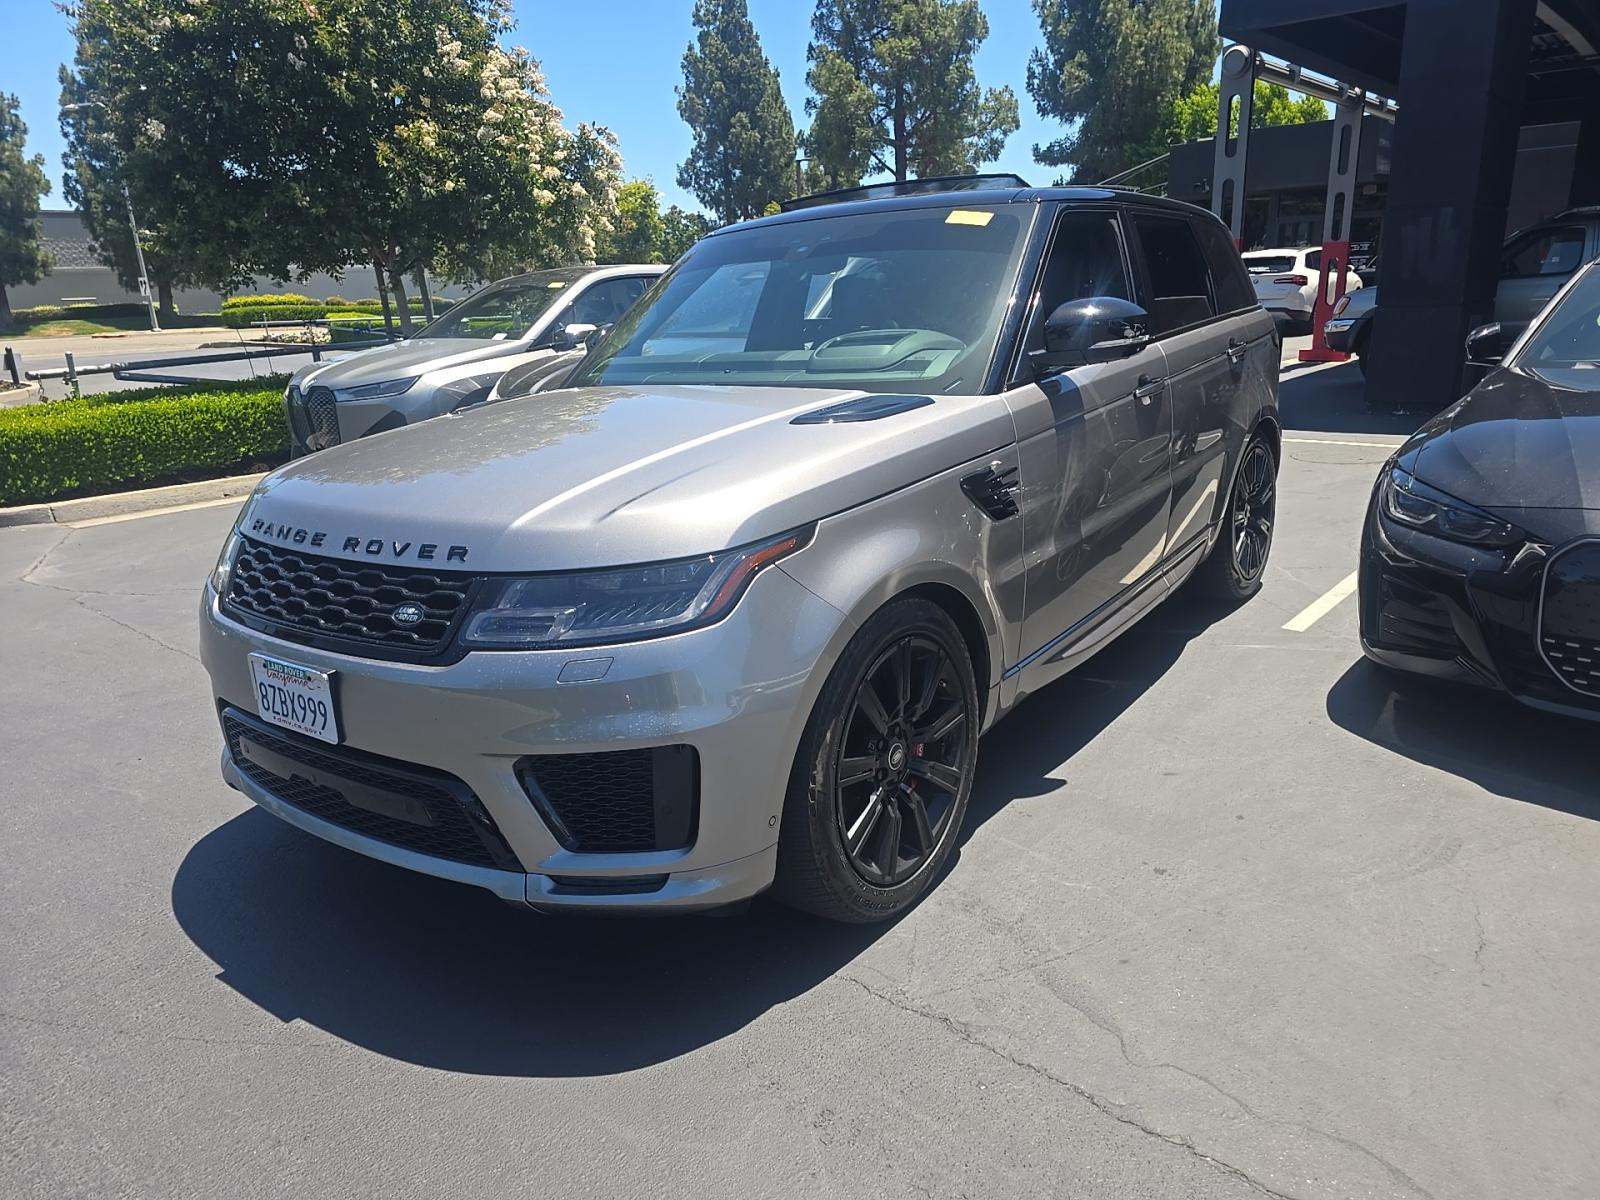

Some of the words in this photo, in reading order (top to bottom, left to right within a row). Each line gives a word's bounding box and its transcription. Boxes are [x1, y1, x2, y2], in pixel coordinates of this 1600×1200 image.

[252, 518, 327, 547] RANGE
[343, 536, 469, 562] ROVER
[268, 661, 283, 672] LAND
[284, 665, 304, 677] ROVER
[259, 682, 328, 731] 8ZBX999
